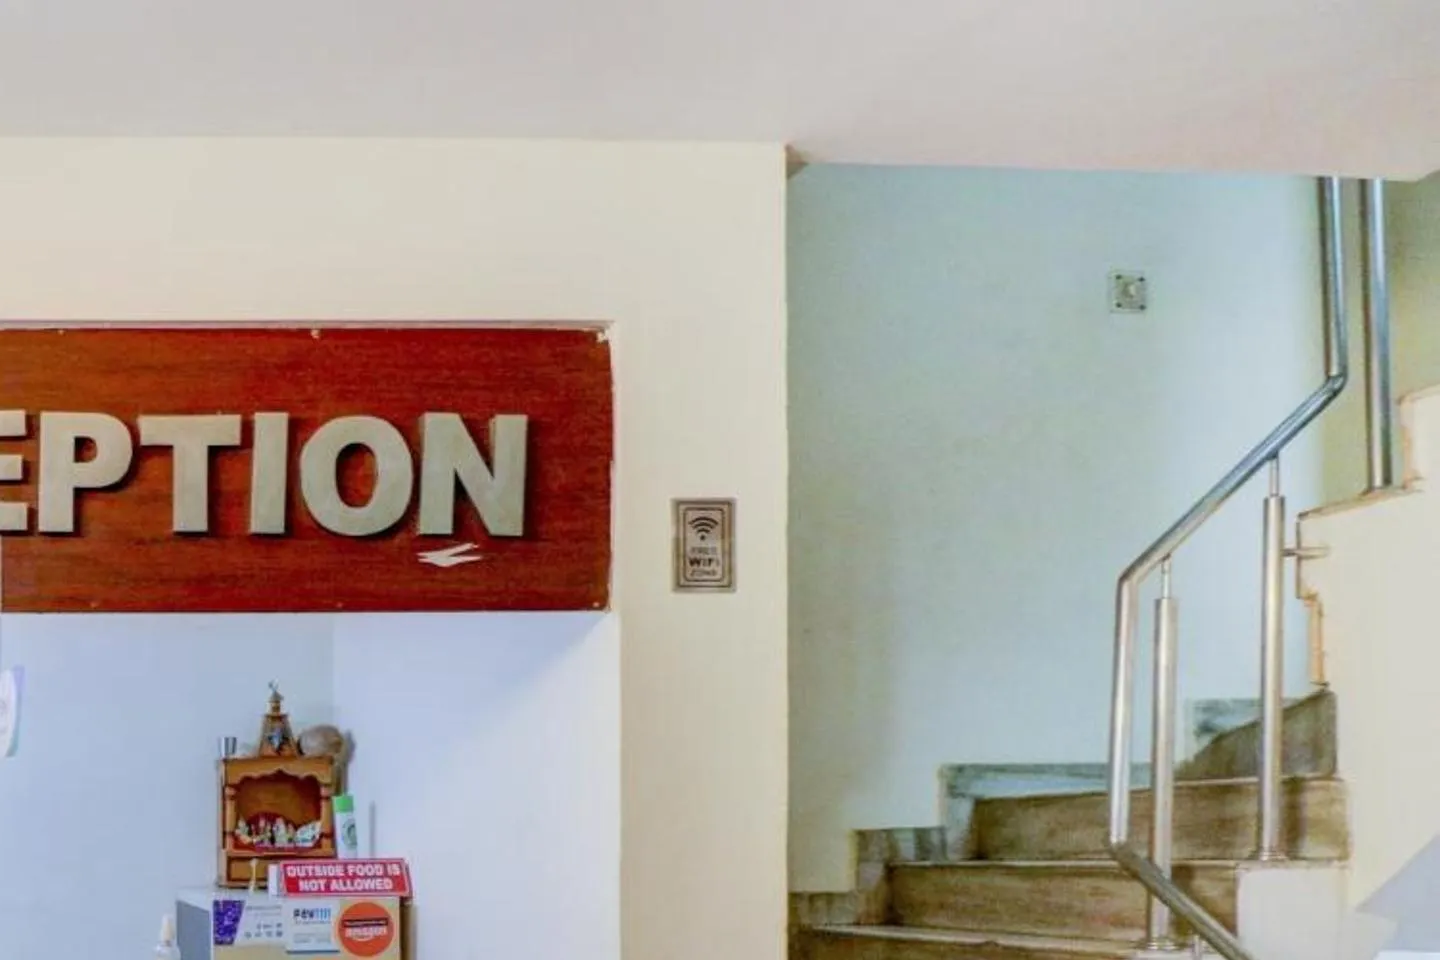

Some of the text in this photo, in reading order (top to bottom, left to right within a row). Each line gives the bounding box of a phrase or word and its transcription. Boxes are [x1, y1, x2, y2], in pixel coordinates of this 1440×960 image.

[286, 863, 400, 877] OUTSIDE FOOD IS
[299, 878, 393, 892] NOT ALLOWED
[344, 926, 388, 938] amazon
